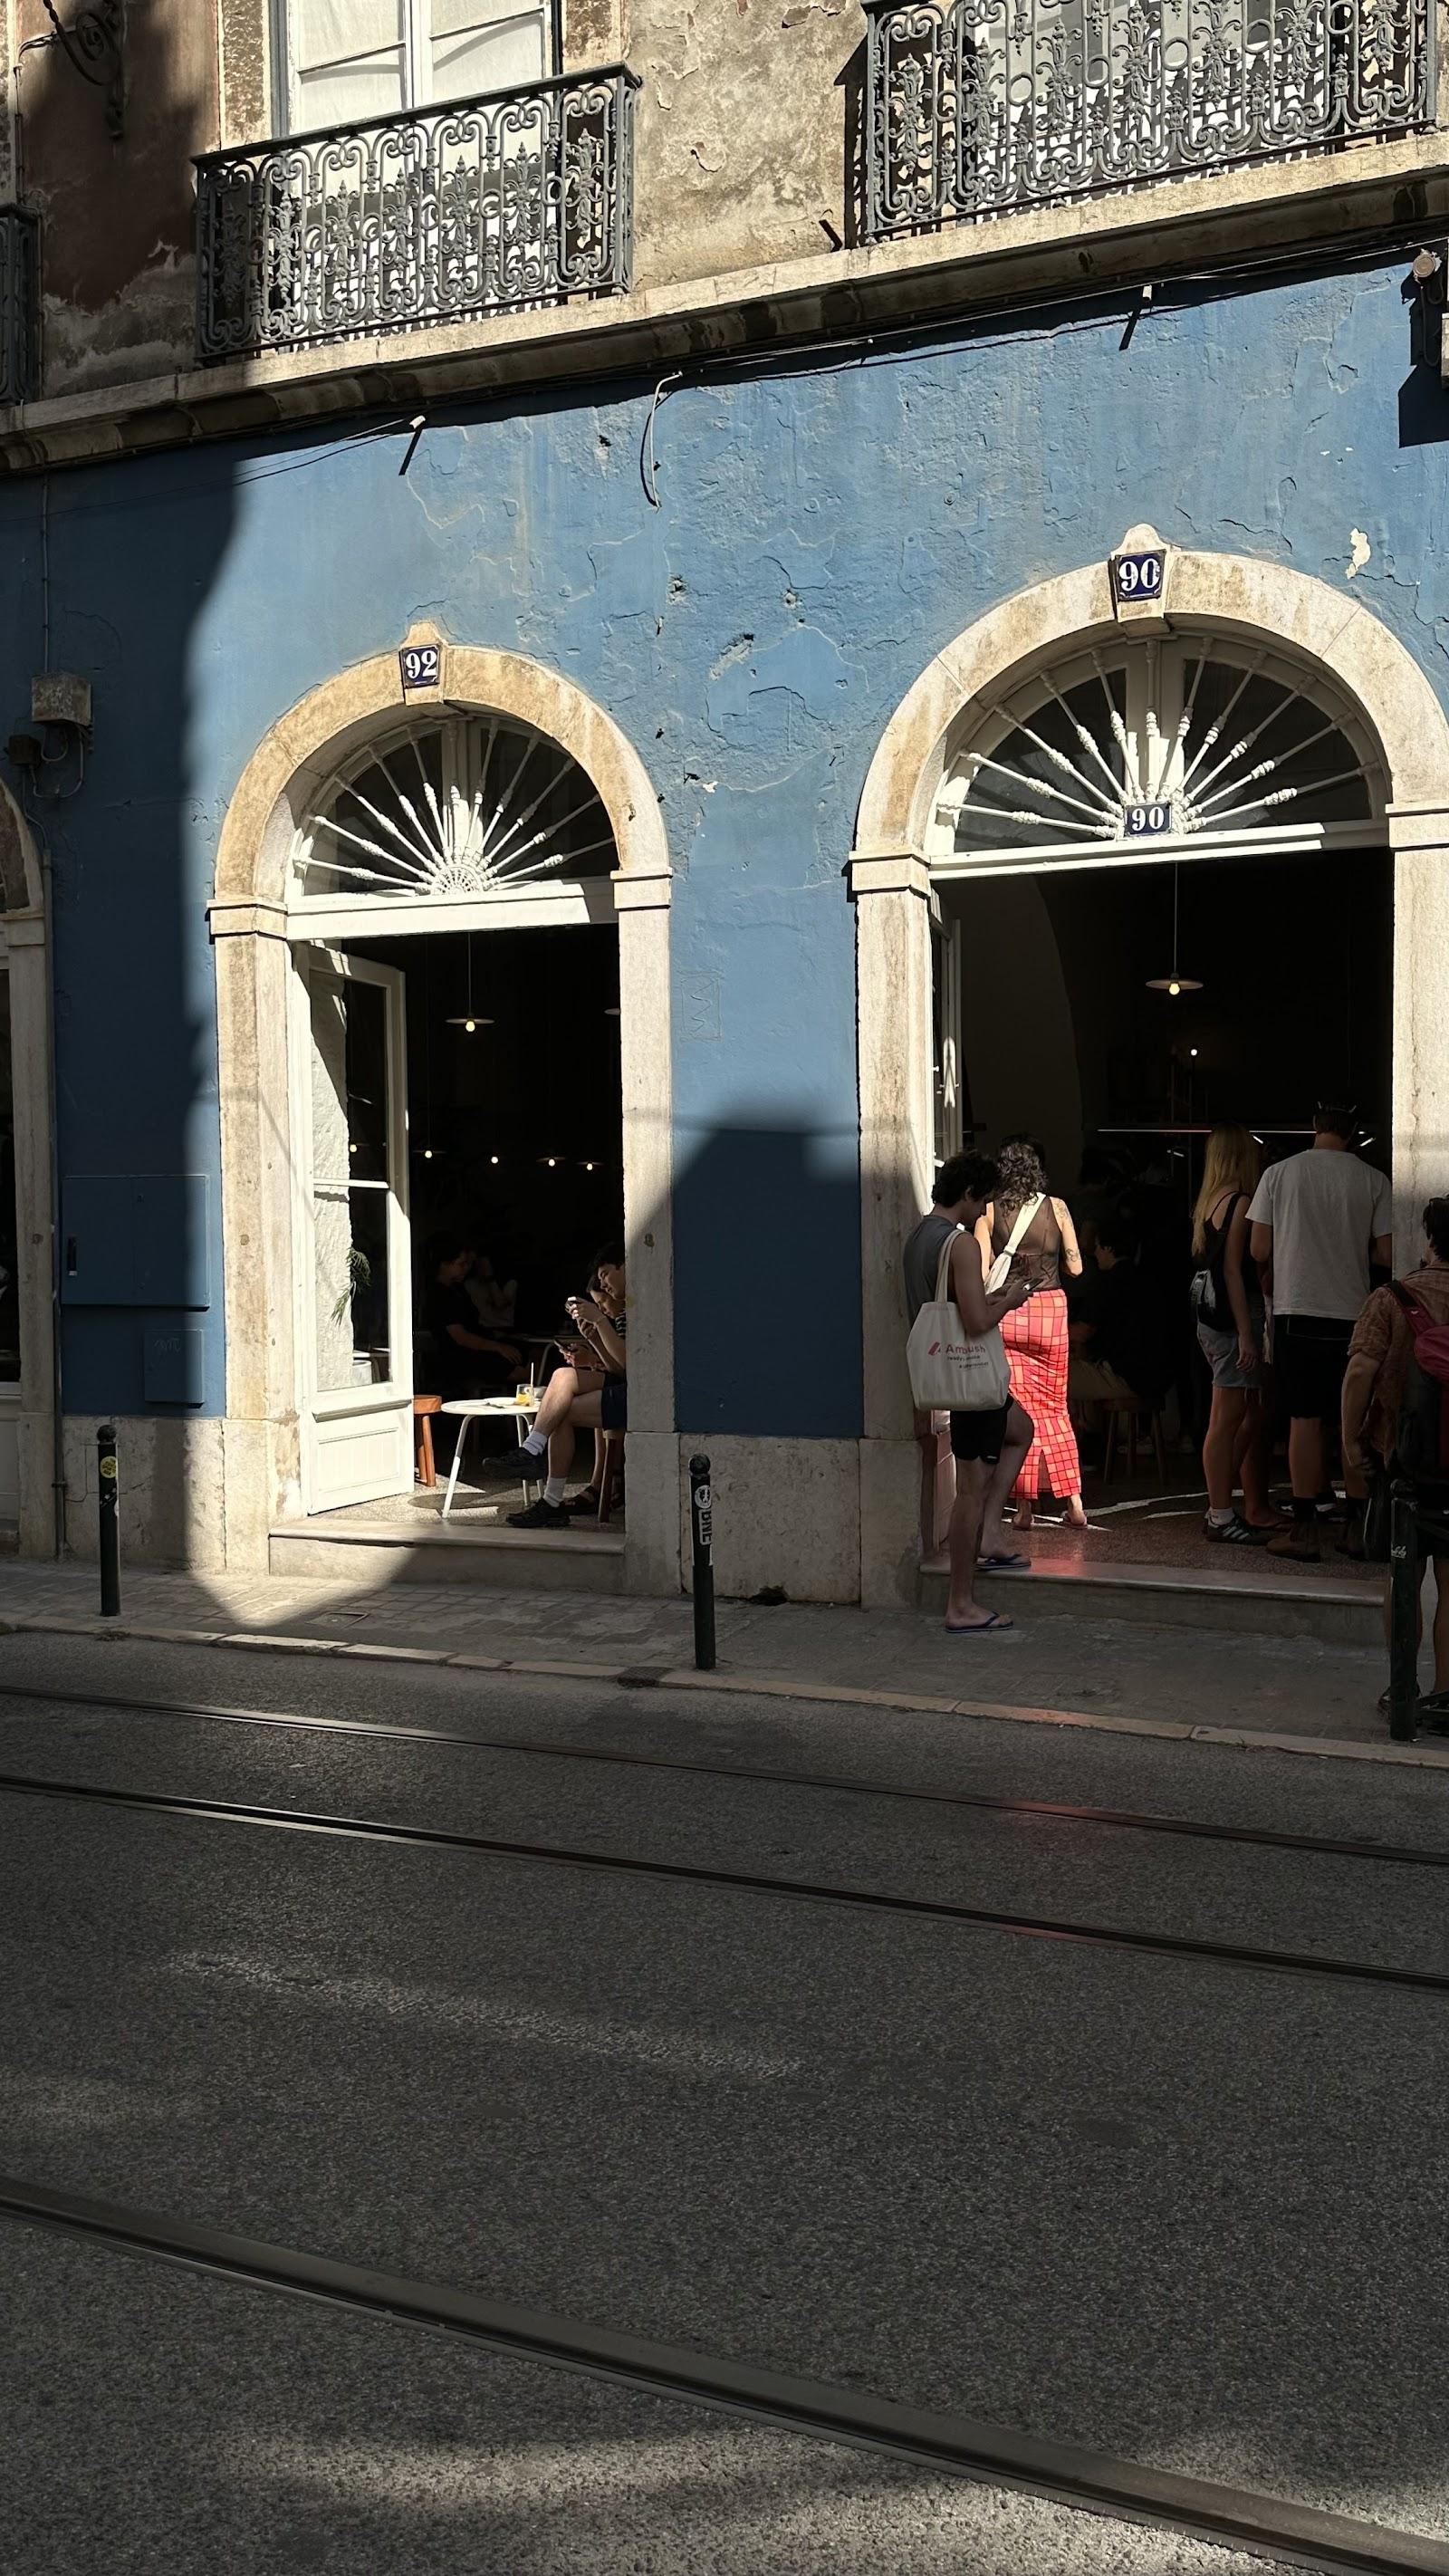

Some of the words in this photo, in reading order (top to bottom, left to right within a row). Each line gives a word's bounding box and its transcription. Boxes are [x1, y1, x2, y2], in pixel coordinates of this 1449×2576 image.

[1118, 558, 1160, 591] 90
[406, 650, 437, 678] 92
[1132, 806, 1165, 831] 90
